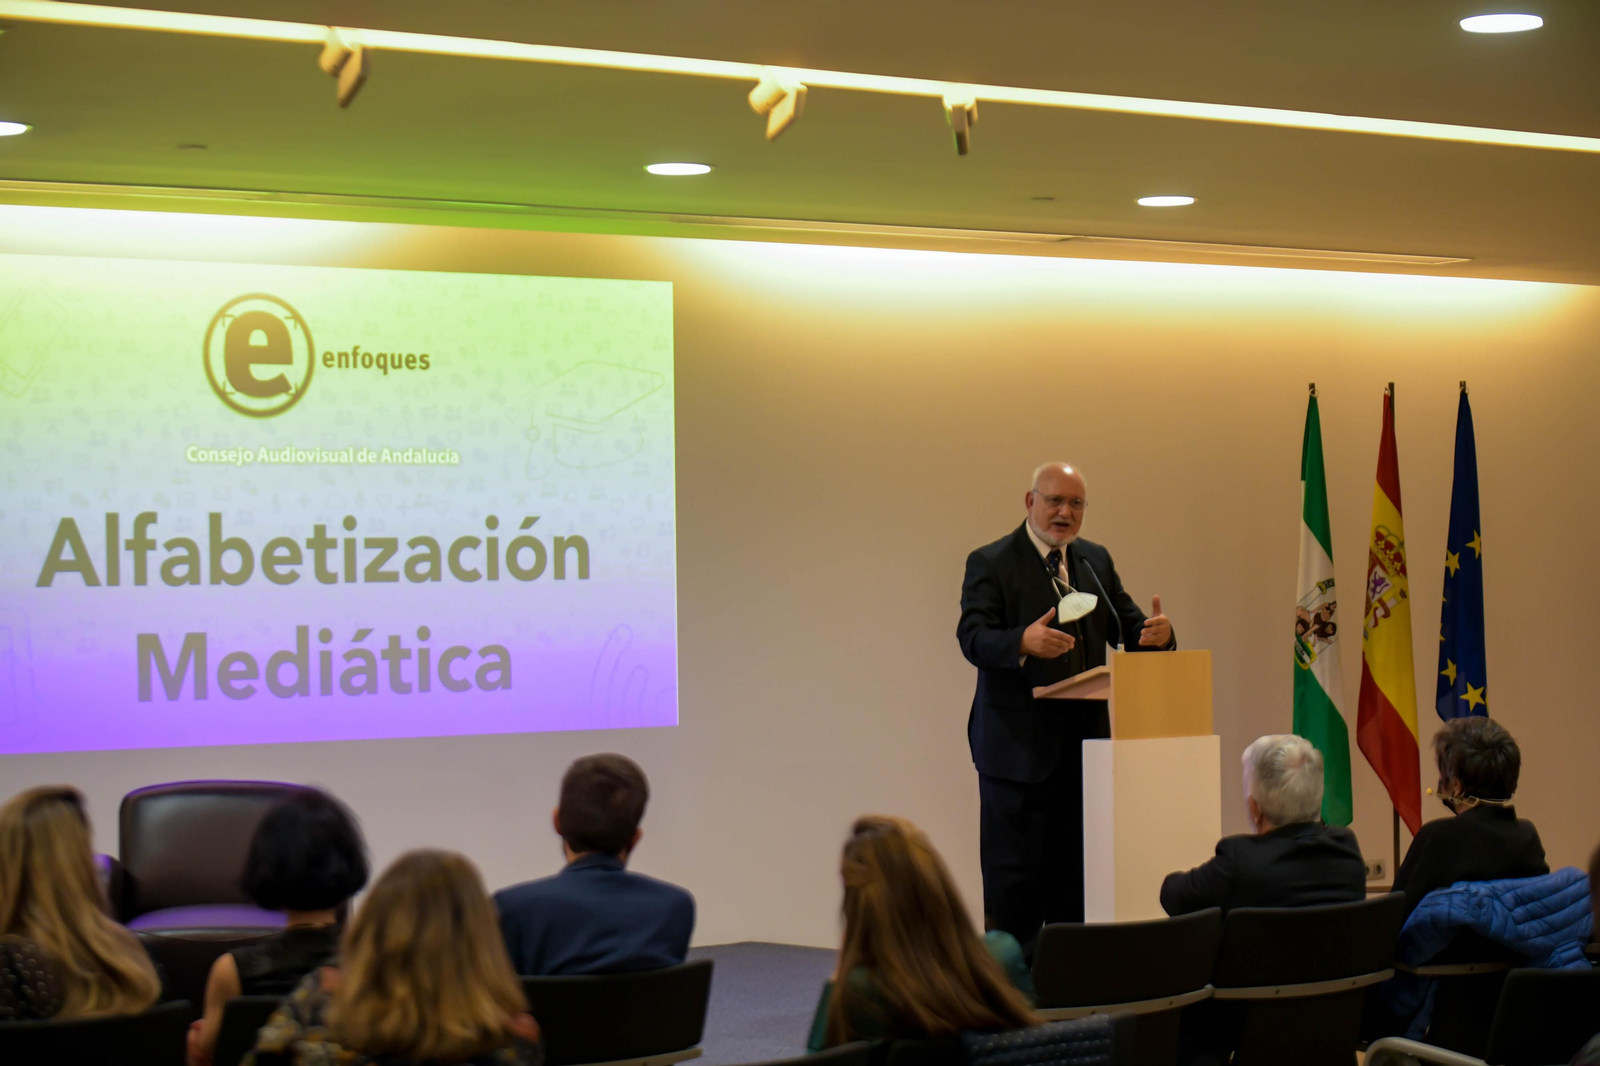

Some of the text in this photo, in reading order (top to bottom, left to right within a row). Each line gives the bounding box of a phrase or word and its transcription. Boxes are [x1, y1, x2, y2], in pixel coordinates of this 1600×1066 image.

[224, 310, 294, 398] e
[322, 345, 431, 375] enfoques
[186, 446, 460, 466] Consejo Audiovisual de Andalucía
[36, 512, 591, 588] Alfabetización
[136, 625, 512, 702] Mediática
